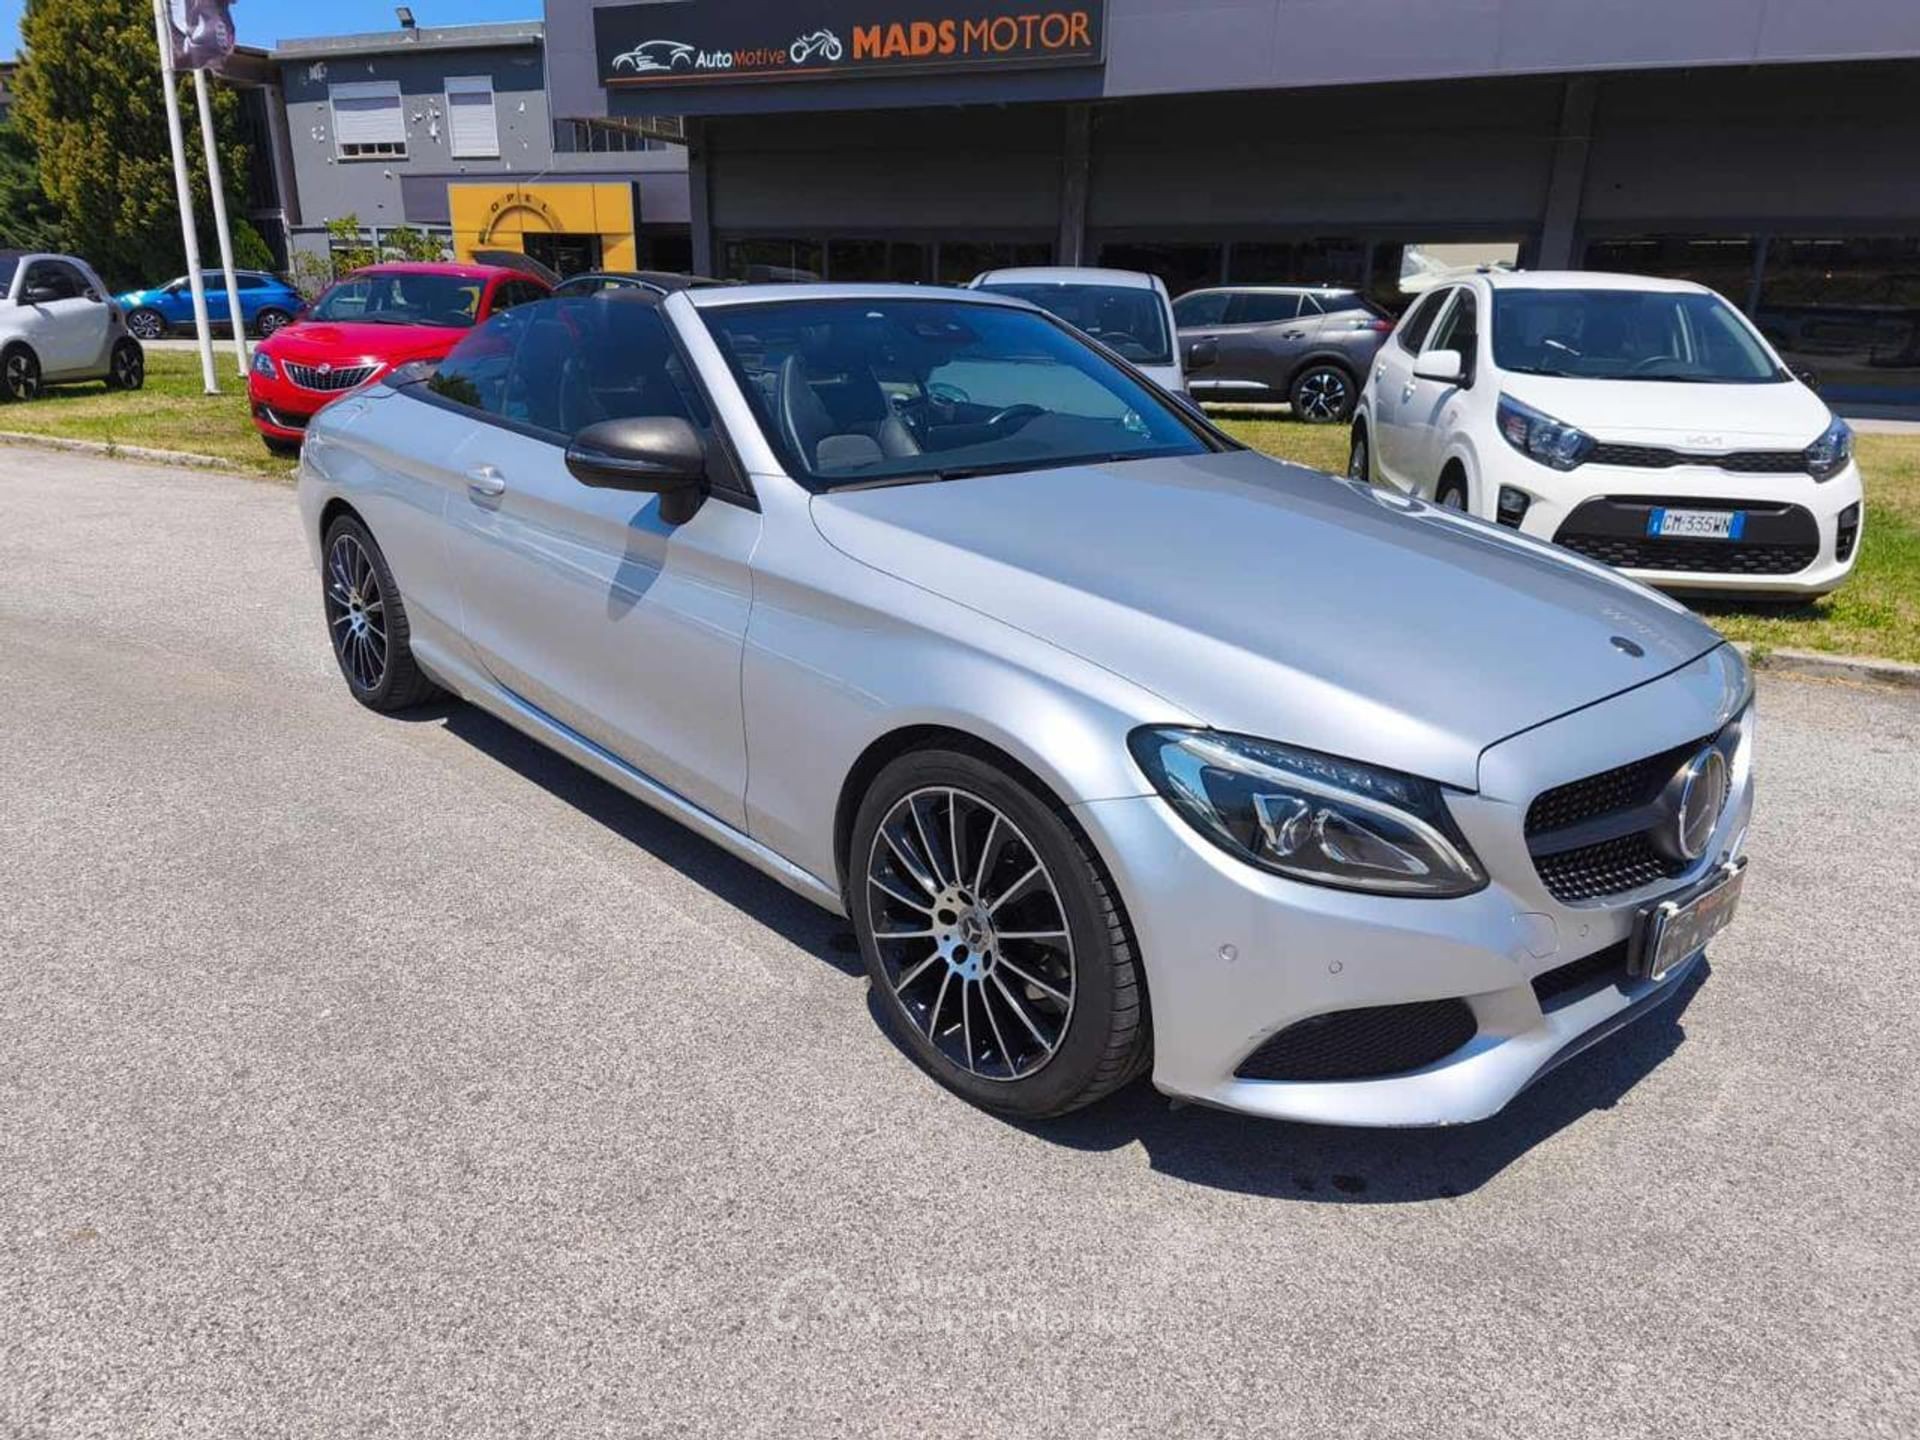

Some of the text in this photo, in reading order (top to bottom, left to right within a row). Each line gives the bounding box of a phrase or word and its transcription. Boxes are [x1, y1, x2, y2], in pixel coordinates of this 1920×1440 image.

[852, 11, 1093, 60] MADS MOTOR
[695, 48, 787, 69] AutoMotive
[490, 193, 550, 213] OPEL
